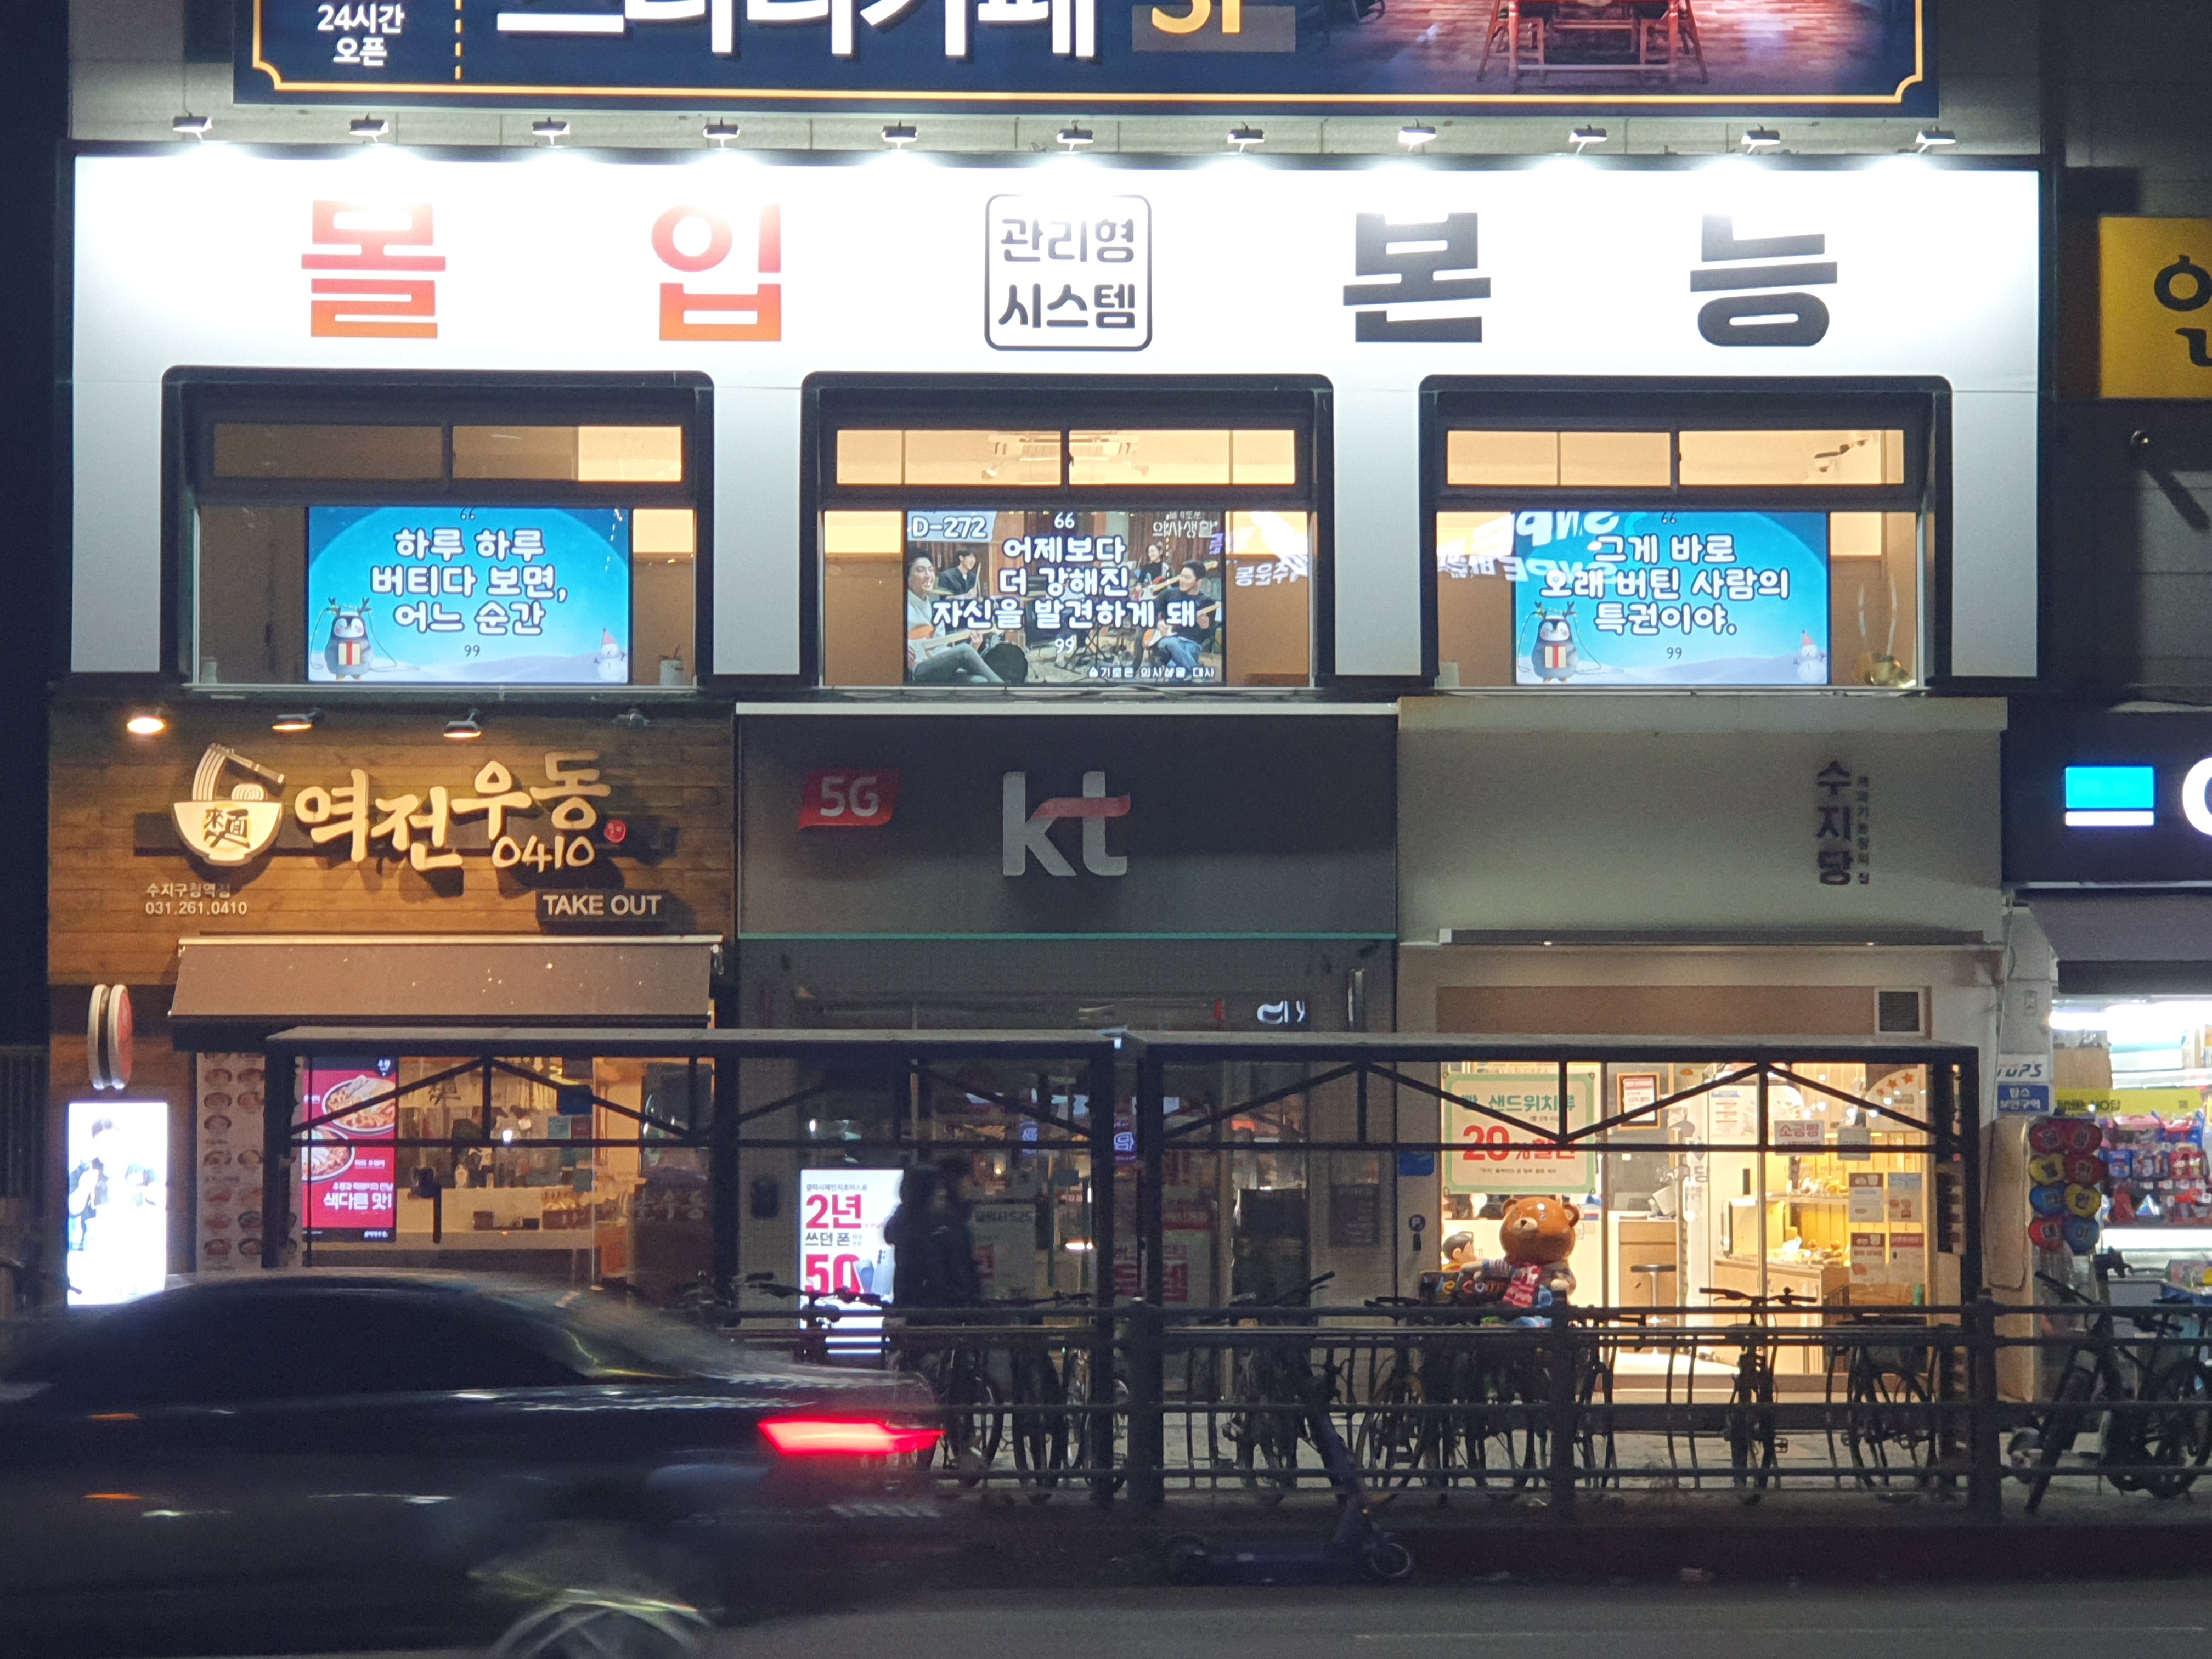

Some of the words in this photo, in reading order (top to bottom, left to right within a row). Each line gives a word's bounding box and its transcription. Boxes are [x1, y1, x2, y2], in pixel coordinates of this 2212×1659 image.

[317, 3, 406, 35] 24시간
[332, 36, 388, 67] 오픈
[1000, 218, 1134, 263] 관리형
[998, 283, 1135, 329] 시스템
[911, 516, 988, 539] D-272
[1152, 520, 1215, 539] 의사생활
[393, 528, 465, 562] 하루
[474, 528, 546, 562] 하루
[1003, 537, 1126, 563] 어제보다
[1594, 534, 1659, 564] 그게
[1670, 534, 1737, 564] 바로
[370, 565, 477, 597] 버티다
[486, 564, 568, 603] 보면,
[1000, 567, 1027, 596] 더
[1039, 567, 1129, 597] 강해진
[1539, 568, 1606, 599] 오래
[1616, 568, 1680, 600] 버틴
[1692, 568, 1790, 600] 사람의
[393, 601, 465, 634] 어느
[475, 601, 546, 635] 순간
[933, 600, 1024, 629] 자신을
[1035, 600, 1155, 629] 발견하게
[1166, 600, 1196, 628] 돼
[1594, 603, 1737, 635] 특권이야.
[1192, 667, 1215, 678] 대사
[295, 750, 612, 871] 역전우동
[820, 776, 879, 817] 5G
[1002, 771, 1131, 877] kt
[1817, 760, 1854, 885] 수지당
[492, 834, 596, 873] 0410
[145, 901, 248, 915] 031.261.0410
[543, 895, 605, 916] TAKE
[611, 895, 662, 916] OUT
[323, 1192, 369, 1210] 색다른
[805, 1194, 862, 1229] 2년
[805, 1232, 833, 1246] 쓰던
[836, 1232, 850, 1246] 폰
